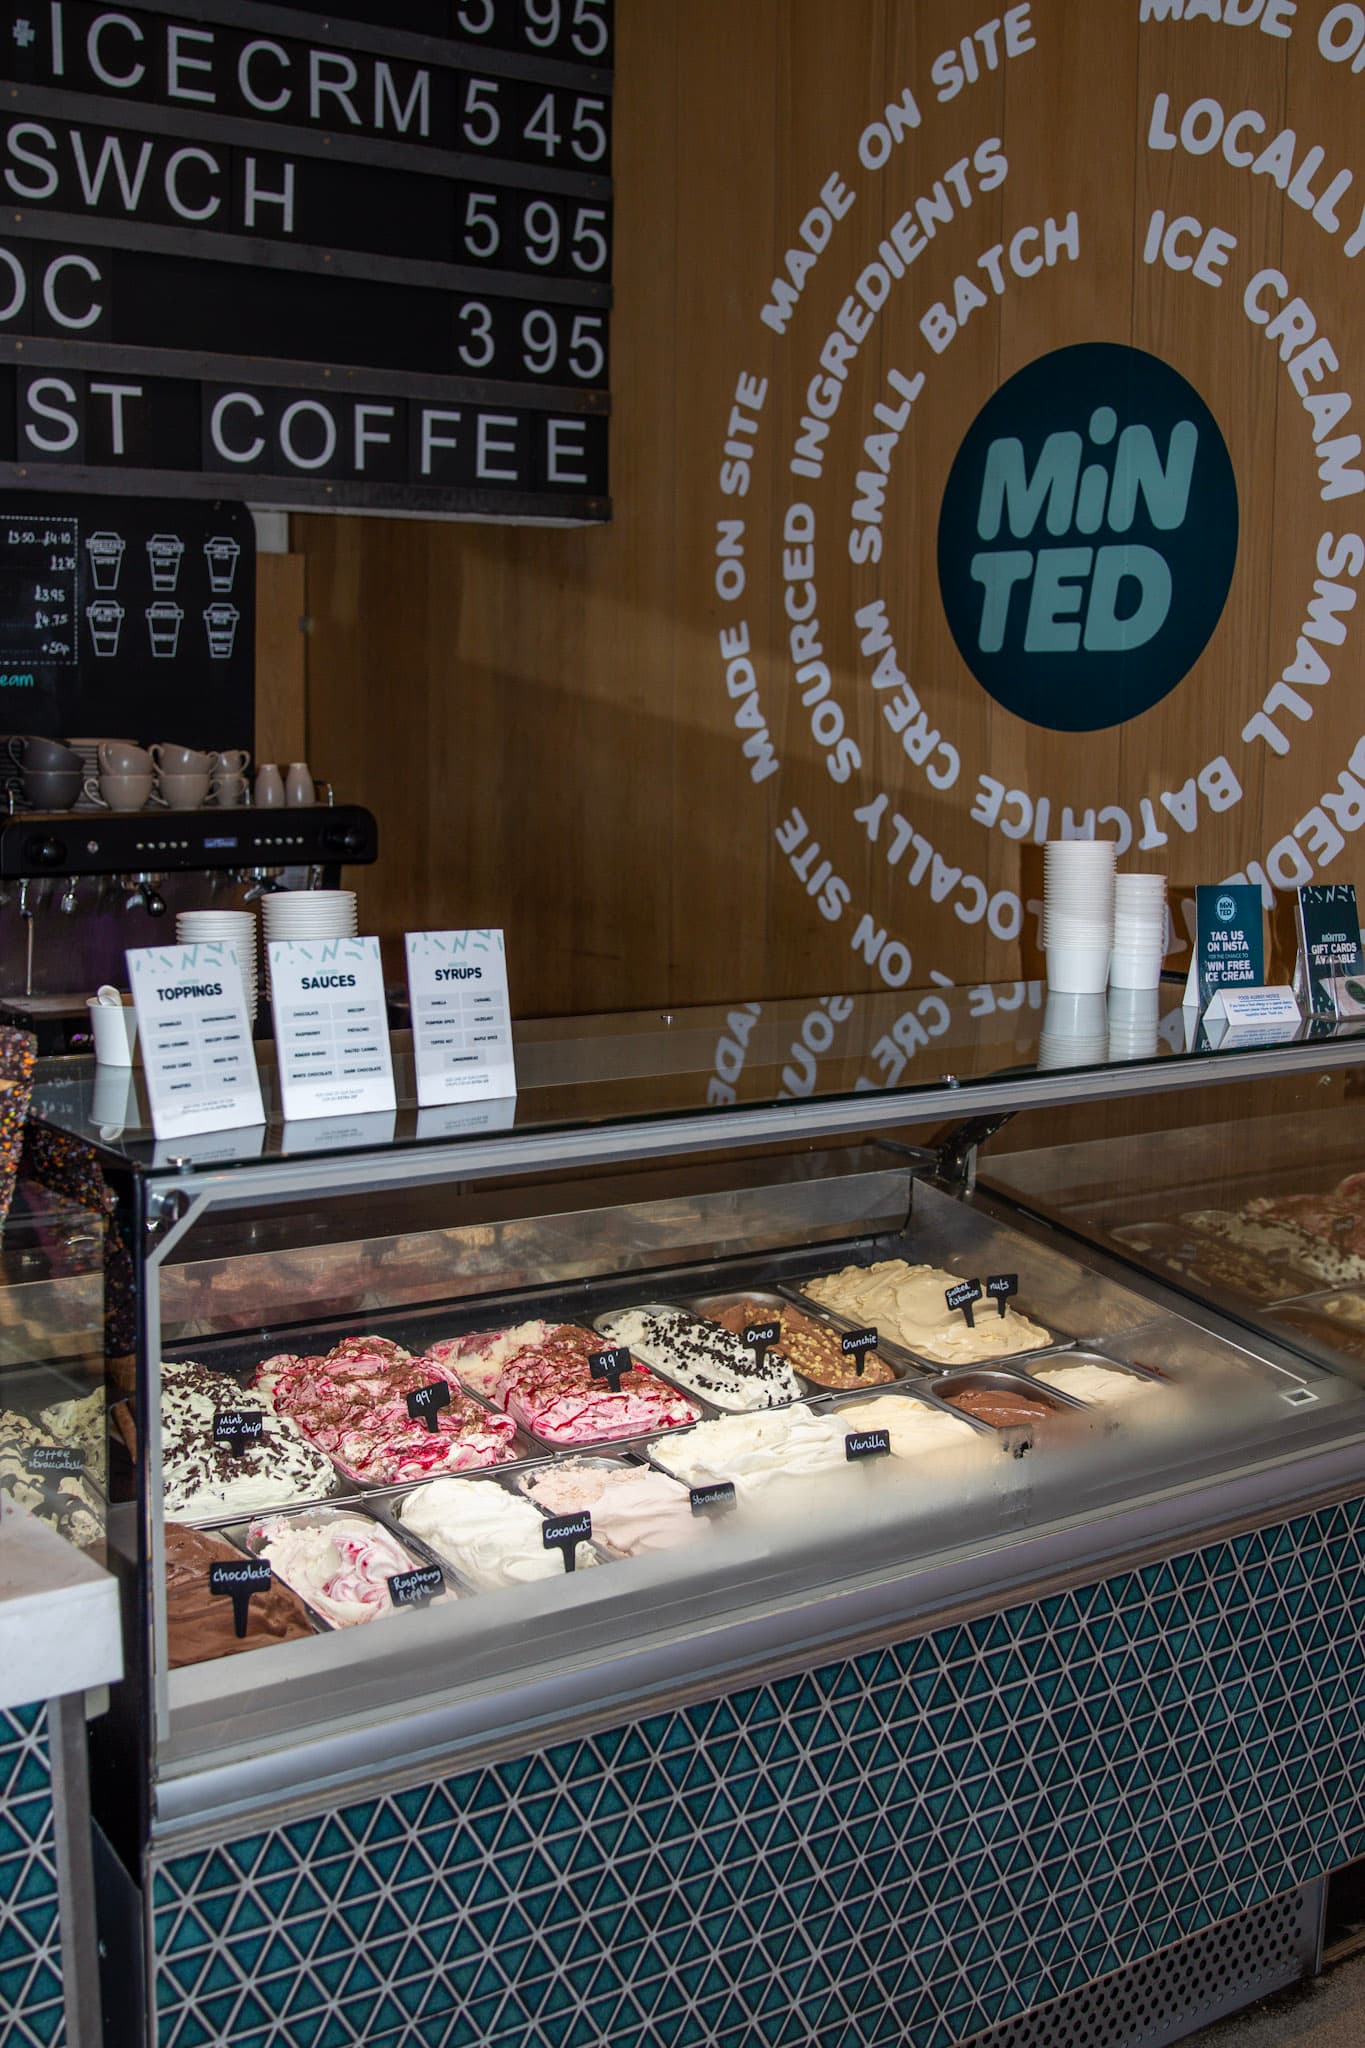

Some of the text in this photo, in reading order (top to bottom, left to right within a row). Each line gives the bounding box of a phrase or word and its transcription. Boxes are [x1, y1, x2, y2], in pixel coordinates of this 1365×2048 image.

[525, 0, 607, 56] 95
[51, 2, 430, 136] ICECRM
[463, 79, 500, 146] 5
[523, 94, 607, 162] 45
[760, 2, 1037, 335] MADE ON SITE
[3, 122, 607, 272] SWCH 5 95
[459, 302, 495, 367] 3
[522, 309, 604, 379] 95
[1143, 209, 1365, 501] ICE CREAM
[848, 211, 1080, 564] SMALL BATCH
[24, 377, 588, 483] ST COFFEE
[783, 137, 1009, 784] SOURCED INGREDIENTS
[715, 371, 780, 783] MADE ON SITE
[970, 544, 1173, 653] TED
[1241, 531, 1365, 756] SMALL
[854, 599, 961, 791] CREAM
[969, 773, 1051, 845] ICE
[775, 807, 912, 987] ON SITE
[1207, 941, 1249, 952] ON INSTA
[1210, 930, 1245, 942] TAG US
[1311, 942, 1357, 955] GIFT CARDS
[156, 982, 223, 1002] TOPPINGS
[301, 974, 357, 991] SAUCES
[434, 966, 483, 981] SYRUPS
[1205, 970, 1255, 982] ICE CREAM
[1207, 960, 1251, 971] WIN FREE
[746, 1328, 774, 1343] Oreo
[842, 1334, 878, 1351] Crunchie
[219, 1413, 243, 1425] Mint
[849, 1434, 886, 1451] Vanilla
[393, 1570, 441, 1591] Raspberry
[398, 1584, 435, 1603] Ripple
